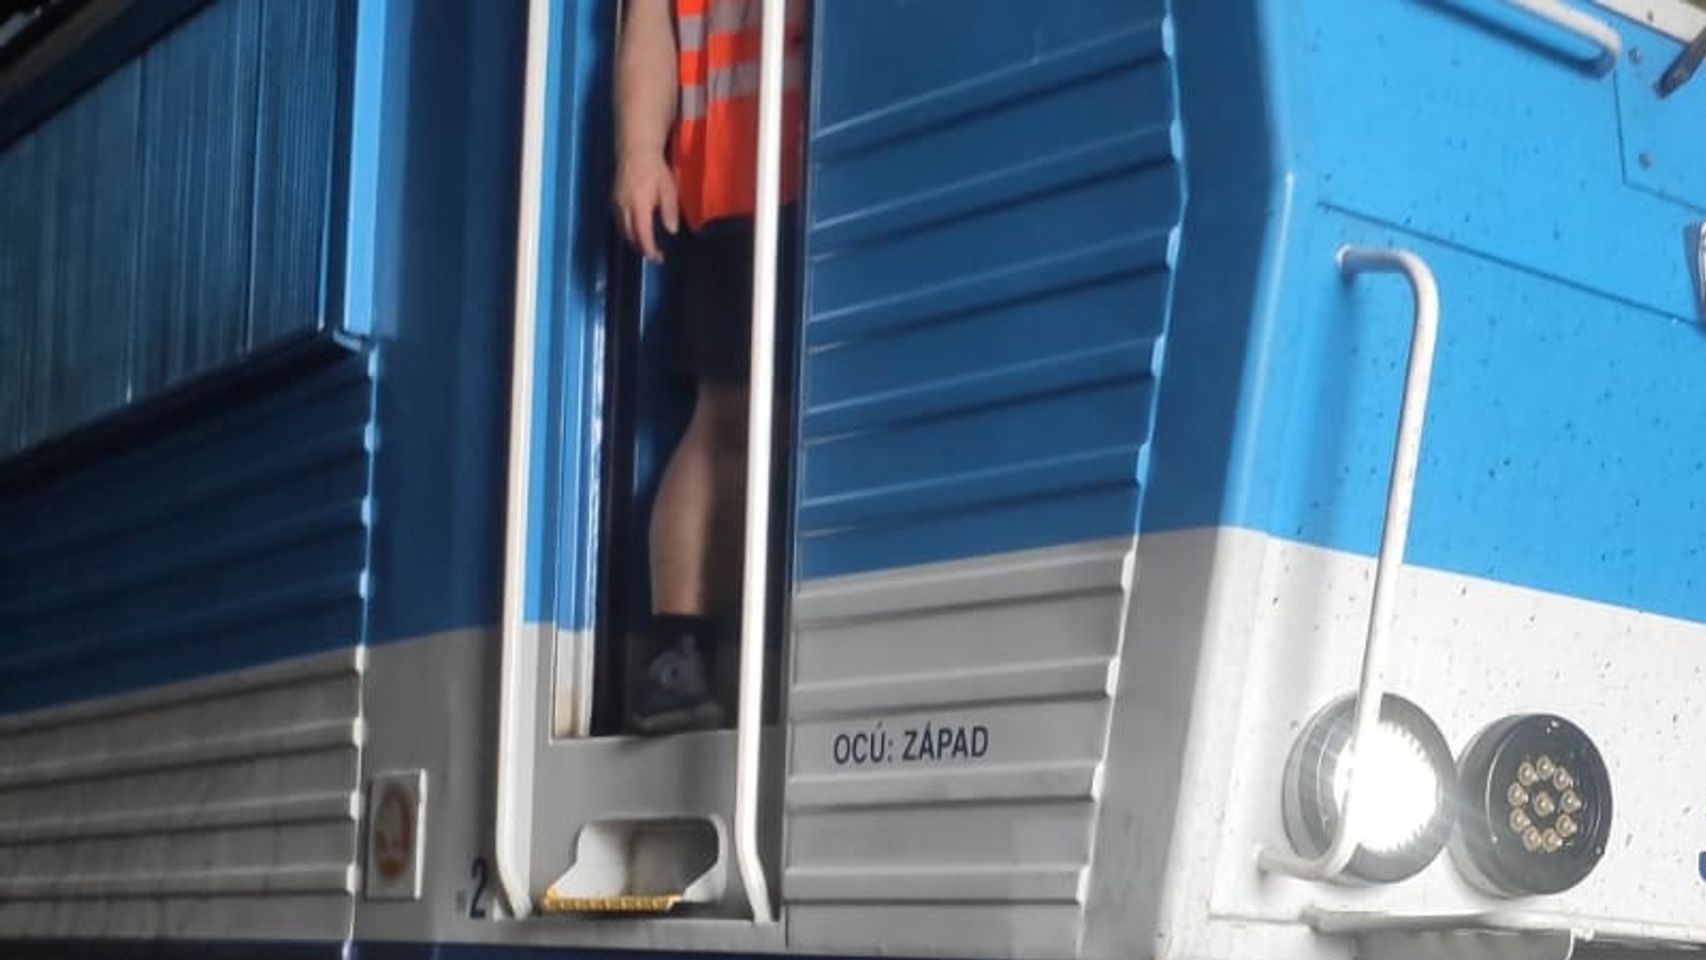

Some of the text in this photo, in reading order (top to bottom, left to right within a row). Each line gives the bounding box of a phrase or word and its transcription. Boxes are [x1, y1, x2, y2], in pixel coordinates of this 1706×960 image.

[833, 719, 989, 765] OCÚ: ZÁPAD
[469, 855, 488, 919] 2
